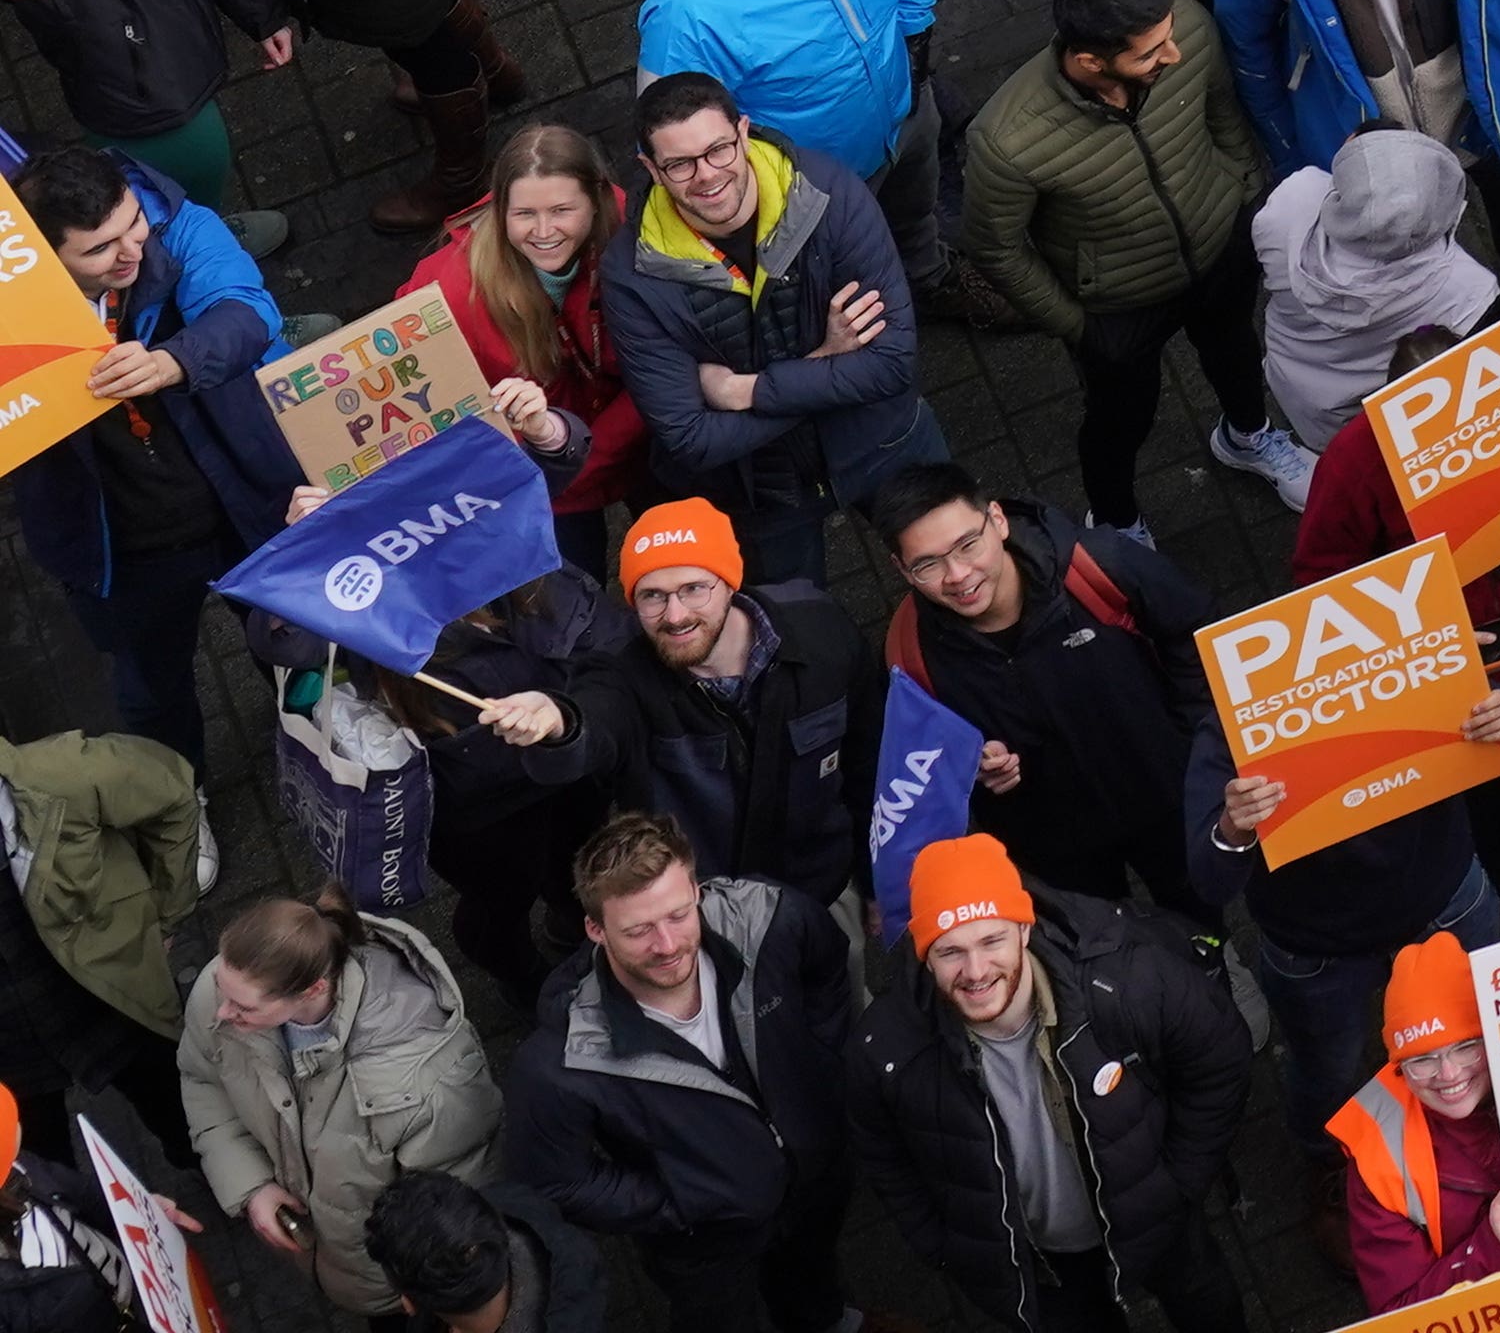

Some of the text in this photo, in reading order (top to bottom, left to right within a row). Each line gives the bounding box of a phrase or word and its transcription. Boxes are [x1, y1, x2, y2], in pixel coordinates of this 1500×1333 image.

[266, 299, 452, 414] RESTORE
[335, 353, 428, 415] OUR
[346, 381, 432, 447] PAY
[366, 491, 501, 566] BMA
[381, 846, 404, 906] BOOKS
